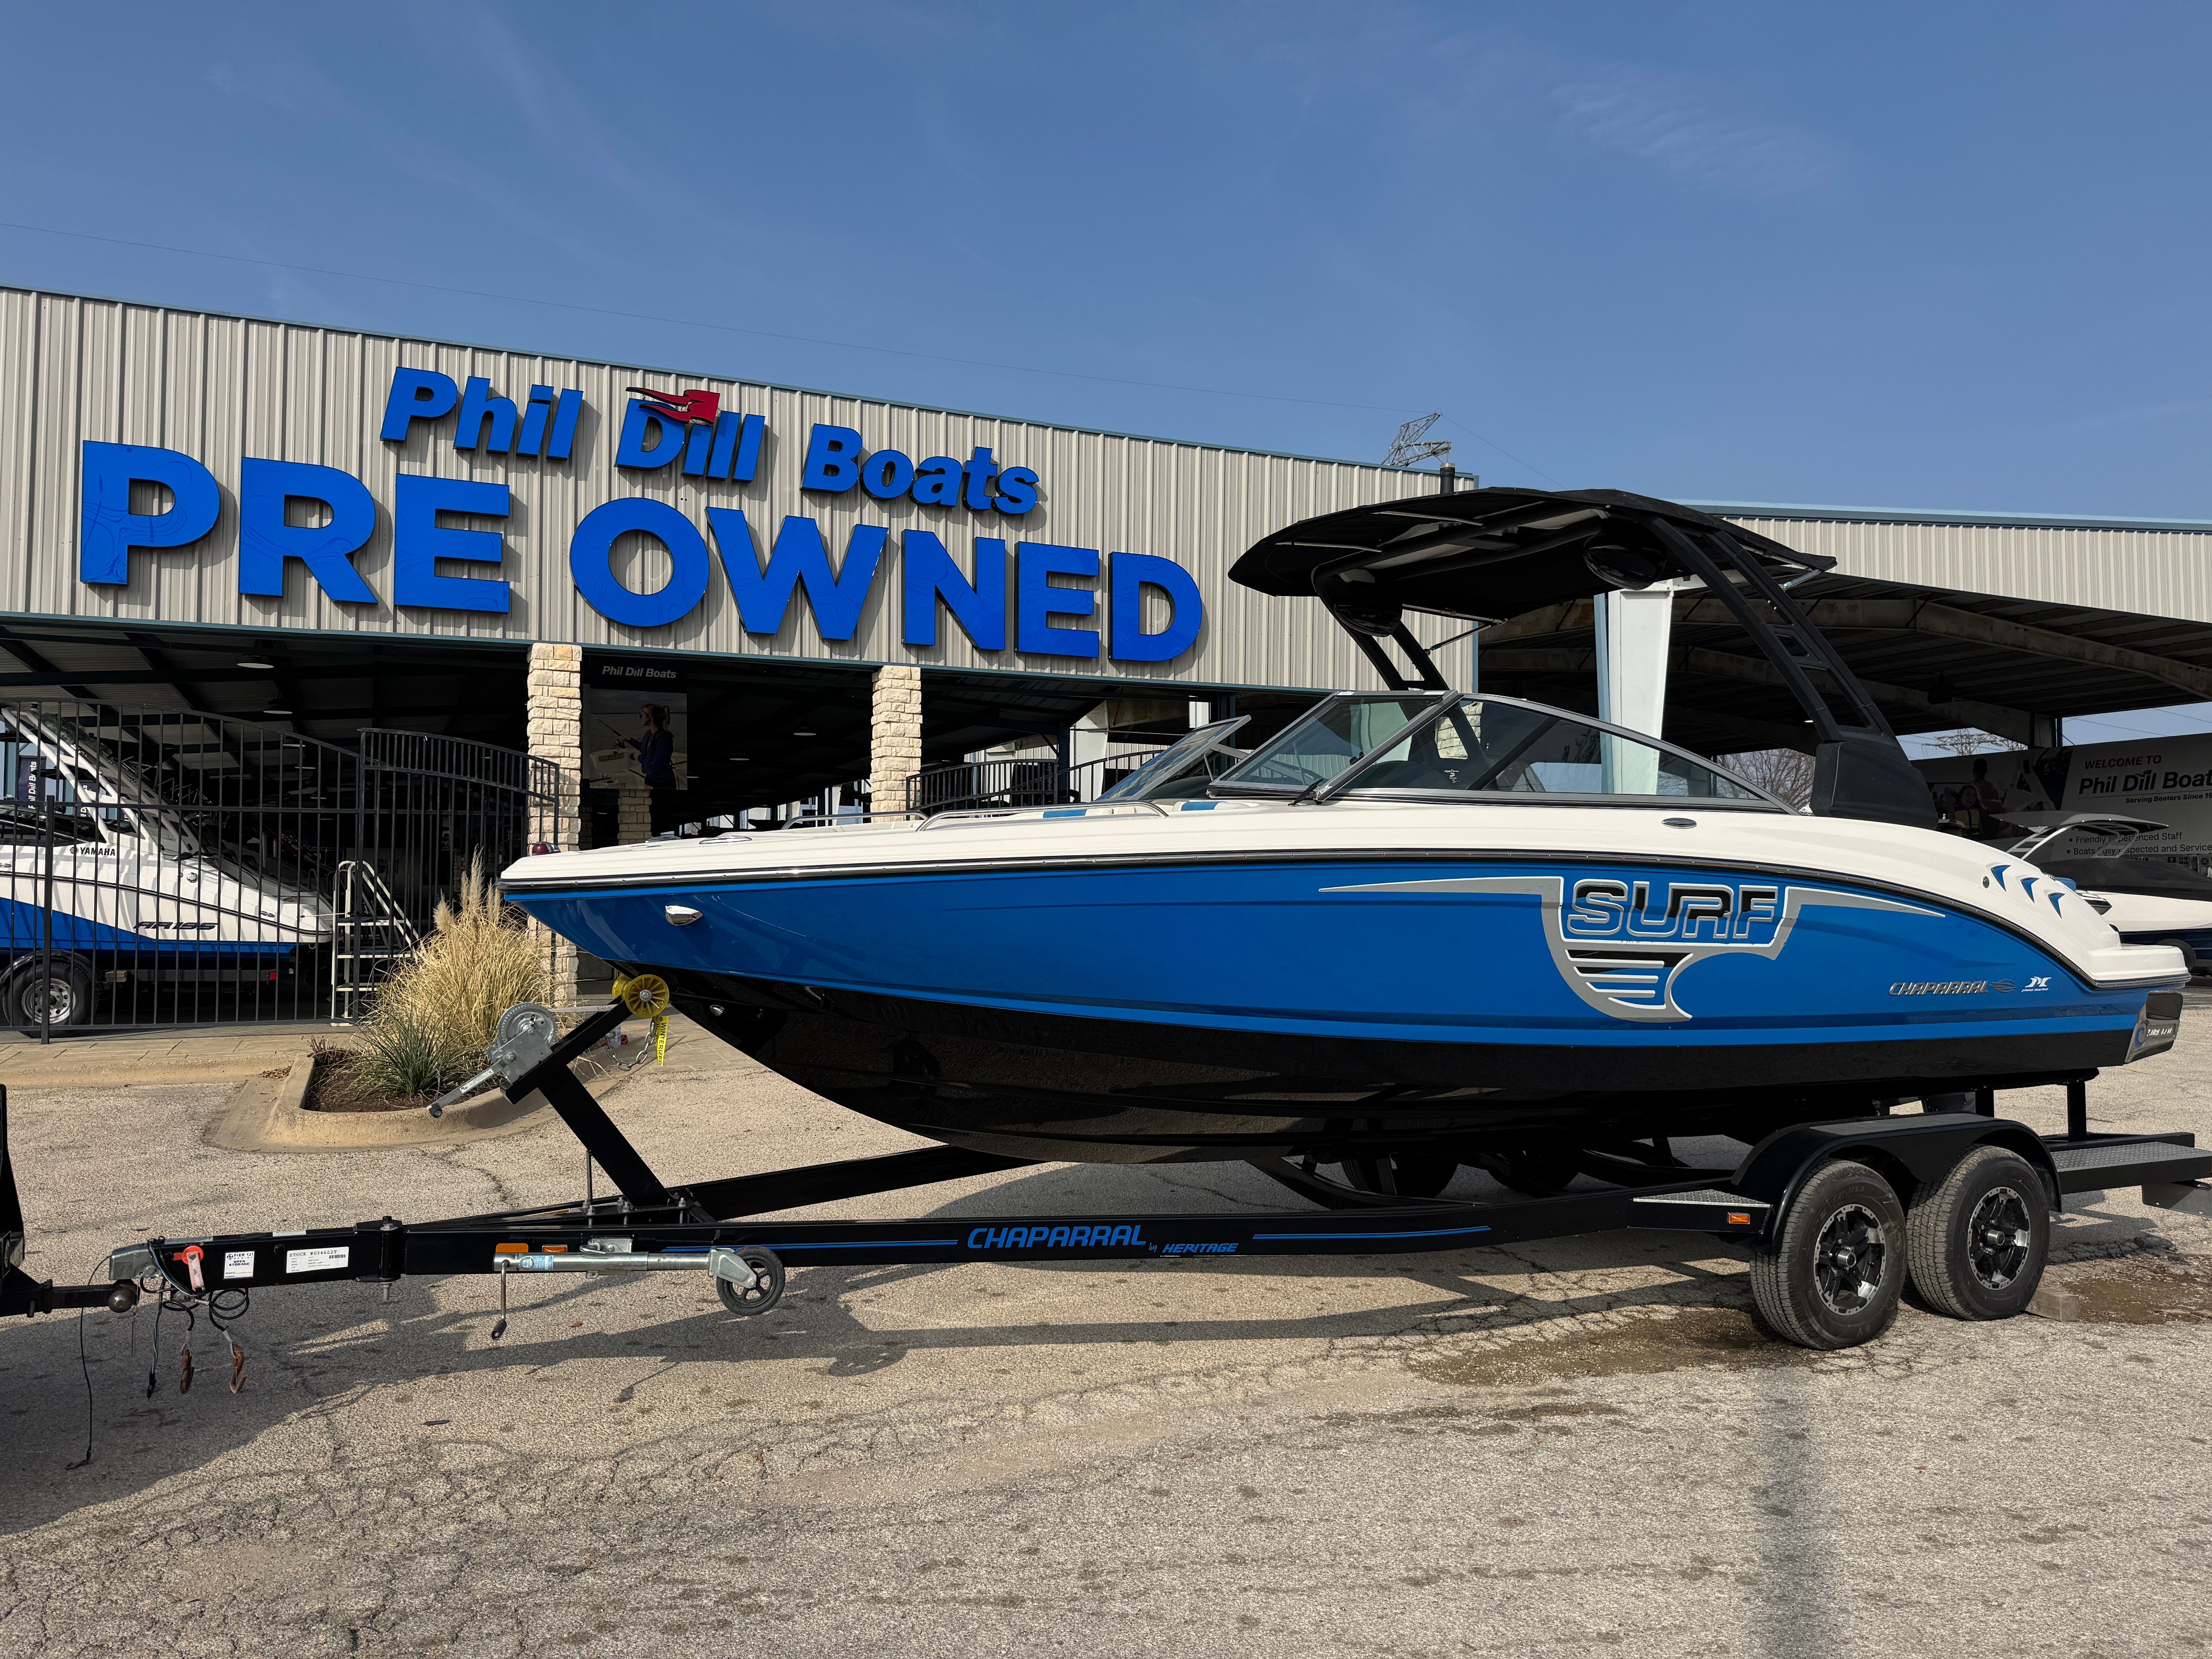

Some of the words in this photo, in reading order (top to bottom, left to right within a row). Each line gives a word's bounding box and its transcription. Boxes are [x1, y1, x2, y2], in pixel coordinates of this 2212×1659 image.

[380, 366, 583, 461] Phil
[615, 395, 765, 483] Dill
[800, 423, 1039, 515] Boats
[80, 440, 510, 614] PRE
[570, 497, 1203, 663] OWNED
[602, 666, 623, 675] Phil
[625, 667, 643, 677] Dill
[646, 668, 676, 678] Boats
[2085, 756, 2143, 769] WELCOME
[2146, 755, 2162, 764] TO
[2078, 776, 2117, 794] Phil
[2122, 773, 2157, 792] Dill
[2076, 835, 2106, 844] Friendly
[80, 847, 115, 855] YAMAHA
[1567, 879, 1778, 938] SURF
[133, 921, 218, 929] AR195
[1889, 981, 1988, 995] CHAPARRAL
[968, 1225, 1146, 1249] CHAPARRAL
[1149, 1242, 1158, 1252] by
[1162, 1243, 1239, 1253] HERITAGE
